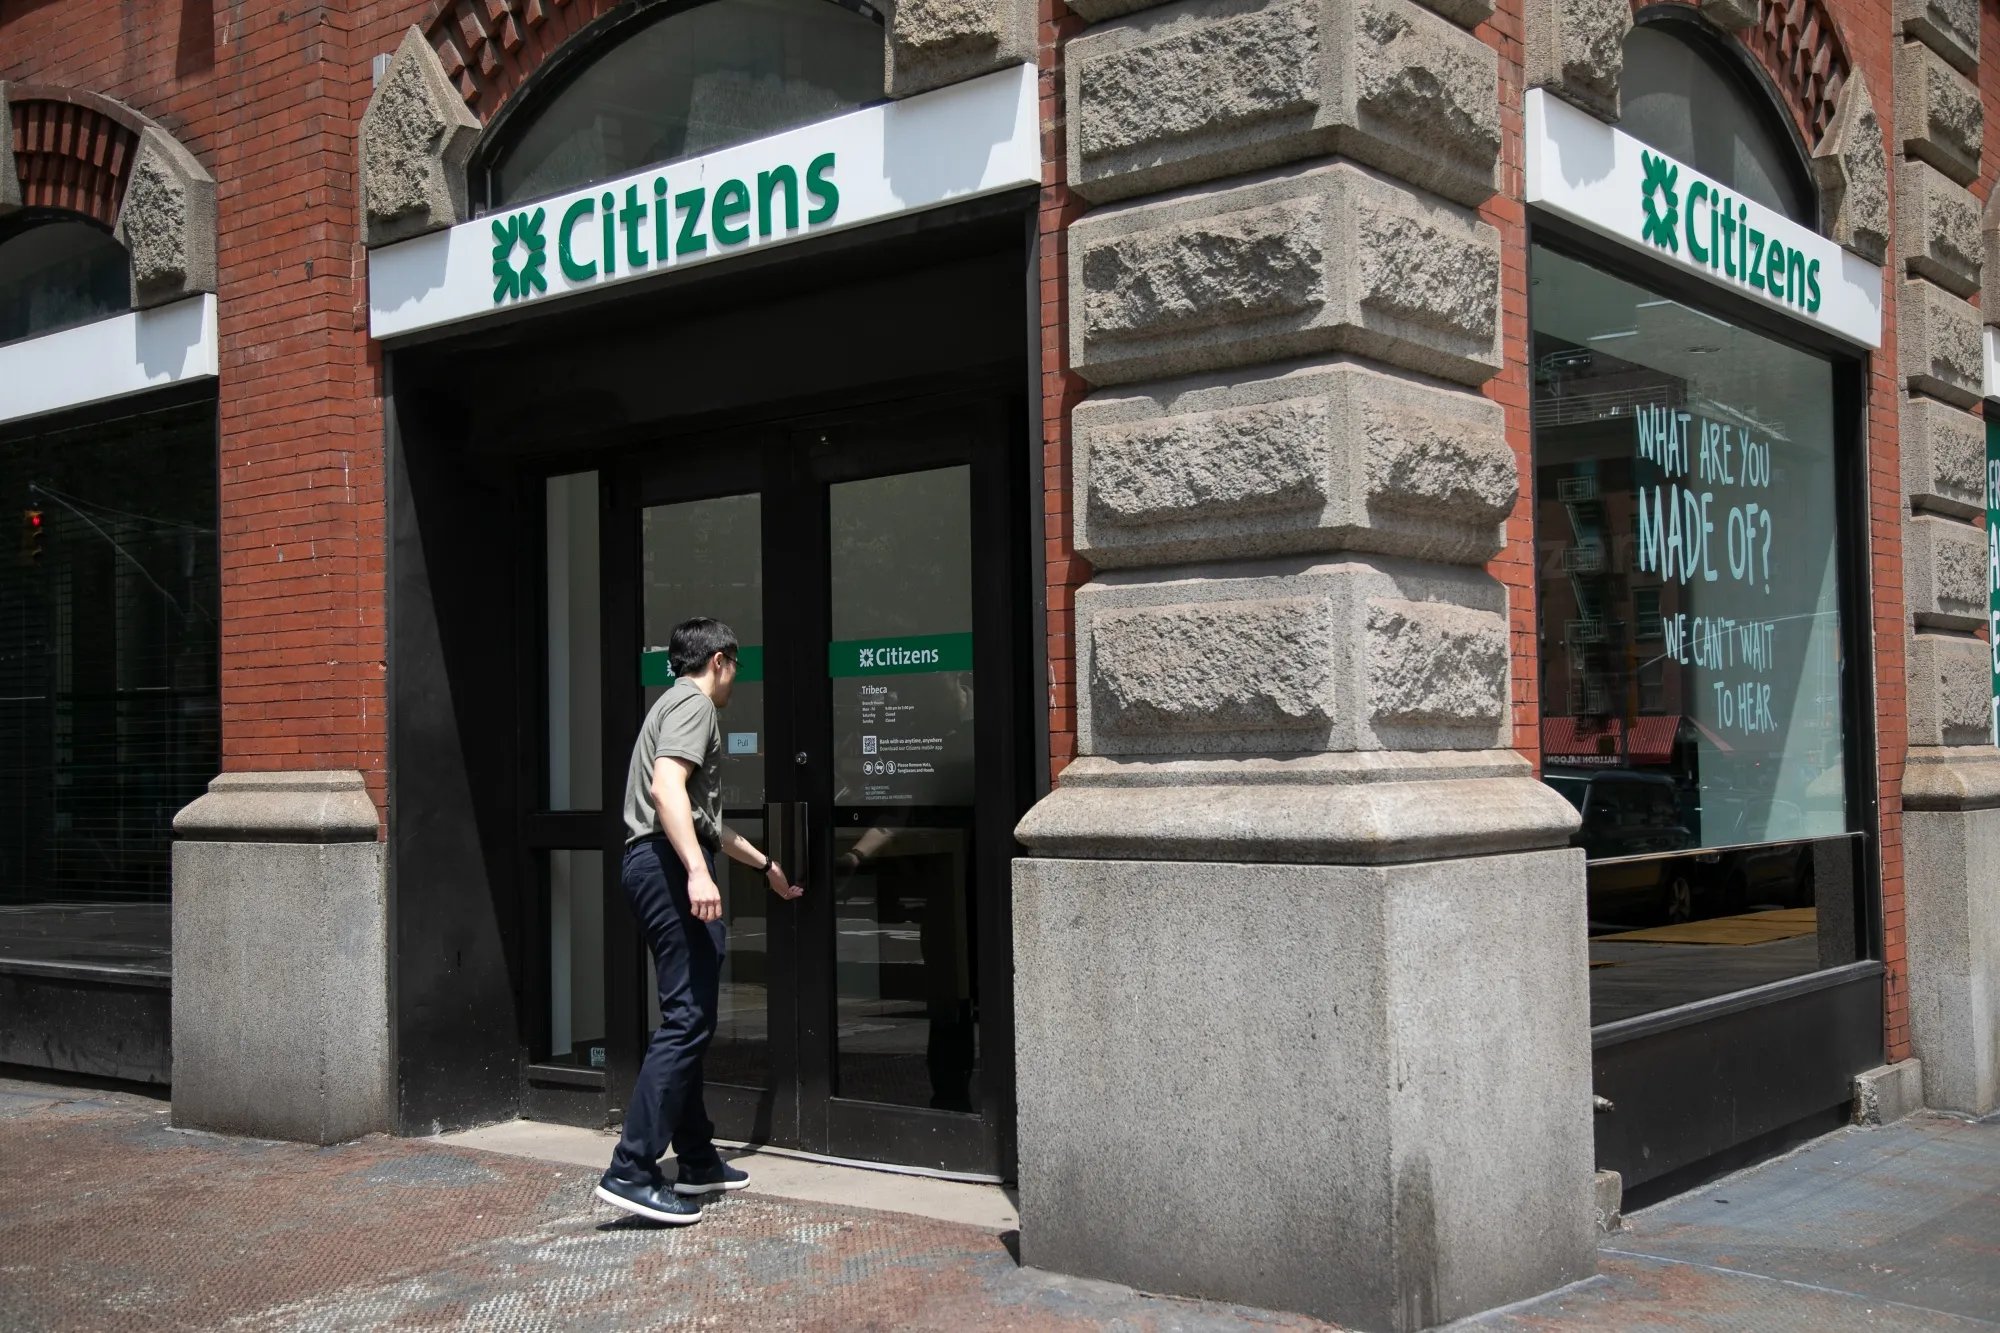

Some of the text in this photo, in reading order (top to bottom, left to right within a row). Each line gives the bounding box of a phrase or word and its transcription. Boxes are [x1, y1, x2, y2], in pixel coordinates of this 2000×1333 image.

[558, 152, 840, 281] Citizens
[1685, 181, 1821, 313] Citizens
[1636, 402, 1770, 488] WHAT ARE YOU
[1640, 483, 1718, 586] MADE
[1728, 503, 1771, 594] OF?
[876, 647, 939, 666] Citizens
[1663, 613, 1774, 673] WE CAN'T WAIT
[862, 685, 887, 695] Tribeca
[1713, 681, 1777, 736] TO HEAR.
[737, 739, 749, 747] Pull
